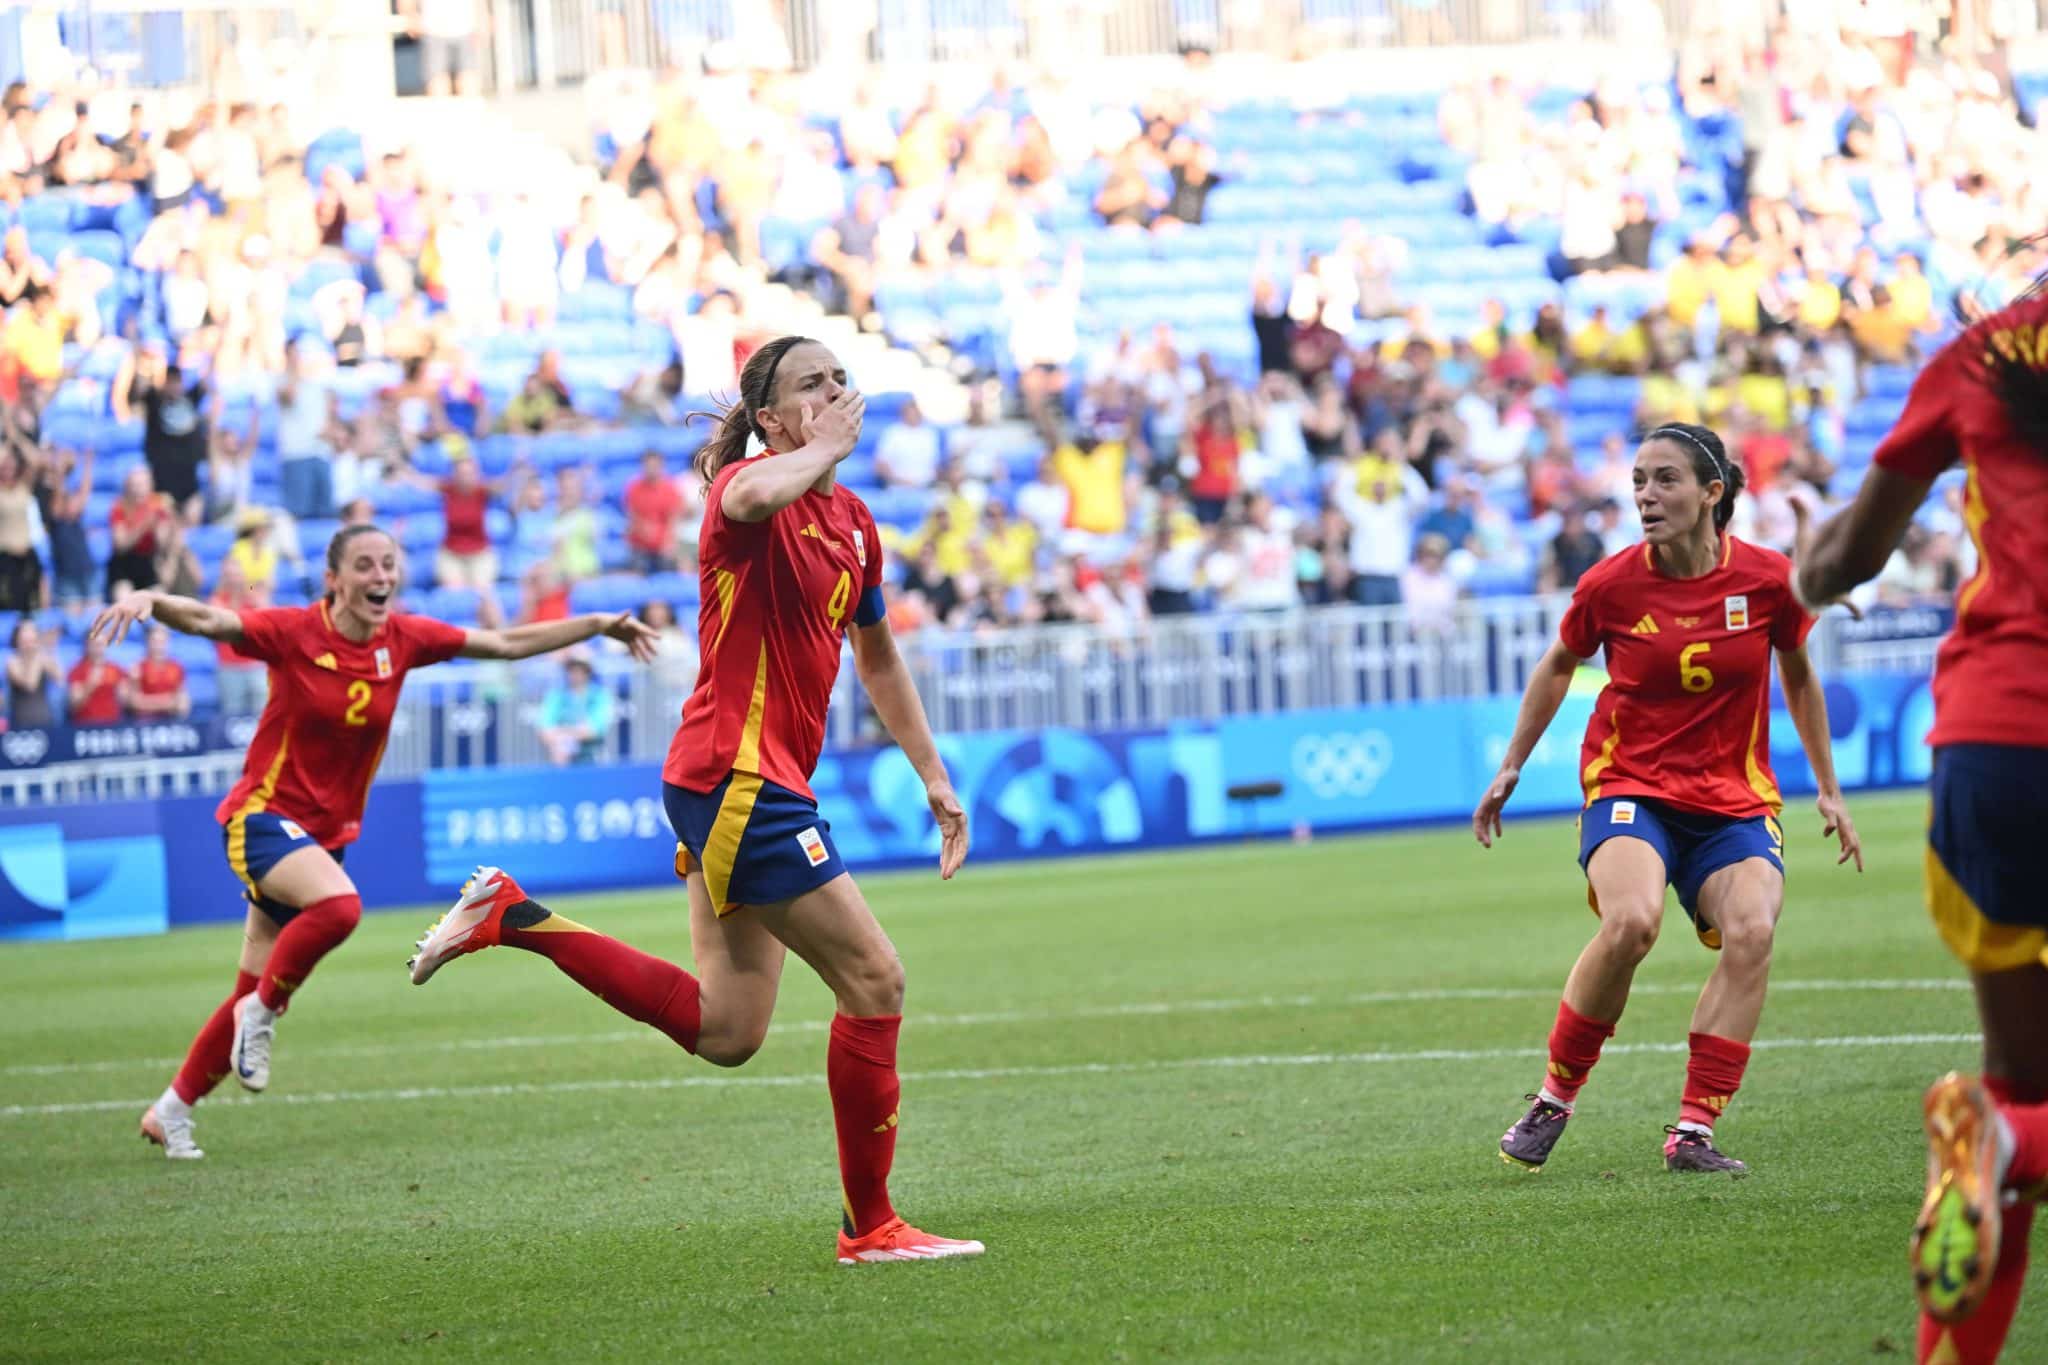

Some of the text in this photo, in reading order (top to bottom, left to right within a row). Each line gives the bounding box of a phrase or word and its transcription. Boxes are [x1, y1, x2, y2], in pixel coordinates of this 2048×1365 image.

[828, 570, 850, 631] 4
[1680, 642, 1714, 692] 6
[346, 680, 371, 725] 2
[447, 803, 567, 848] PARIS
